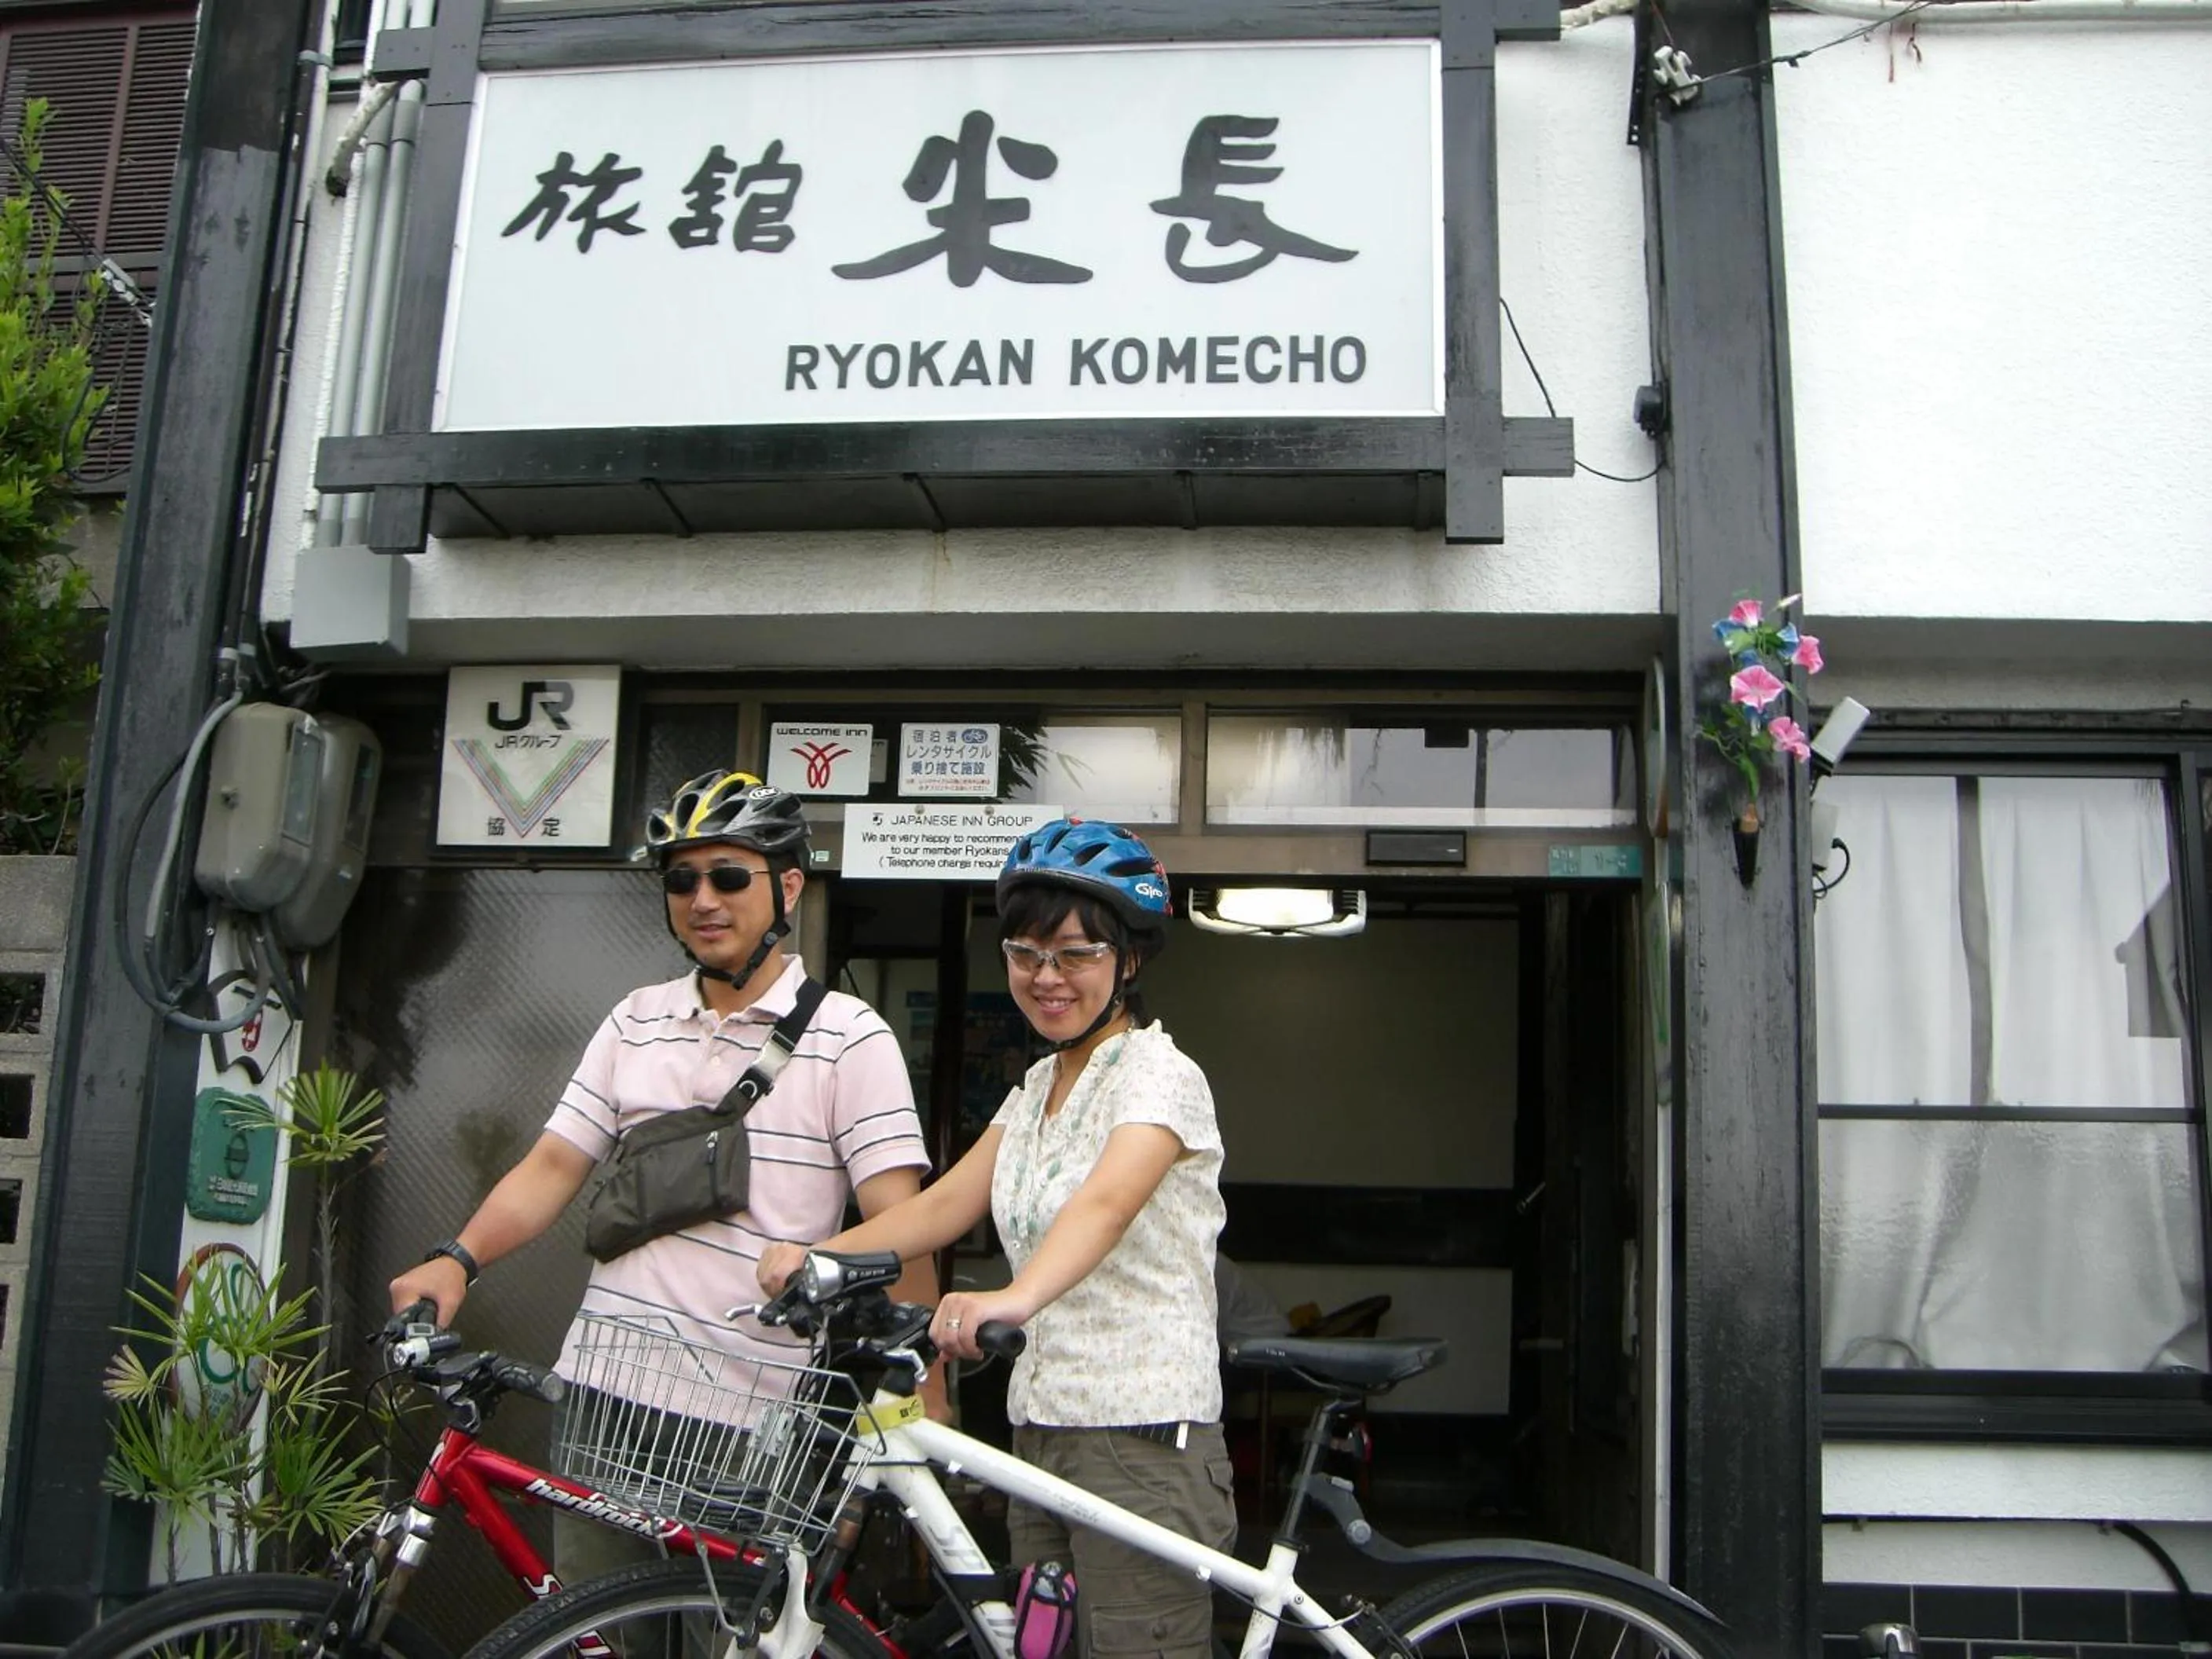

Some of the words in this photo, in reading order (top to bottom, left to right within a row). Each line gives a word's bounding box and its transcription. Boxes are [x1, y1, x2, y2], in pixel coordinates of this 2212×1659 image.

[501, 140, 802, 254] 旅館
[786, 339, 1034, 390] RYOKAN
[1070, 336, 1366, 385] KOMECHO
[488, 681, 574, 731] JR
[906, 745, 992, 759] レンタサイクル
[911, 760, 986, 775] 乗り捨て施設
[891, 815, 958, 826] JAPANESE
[961, 815, 983, 826] INN
[987, 815, 1033, 827] GROUP
[862, 832, 877, 843] We
[879, 833, 896, 843] are
[898, 833, 919, 844] very
[921, 833, 951, 844] happy
[954, 833, 965, 843] to
[891, 846, 901, 855] to
[922, 846, 963, 856] member
[965, 844, 1009, 857] Ryokans
[937, 858, 971, 870] charge
[973, 859, 1007, 869] requir
[1135, 883, 1163, 899] Giro
